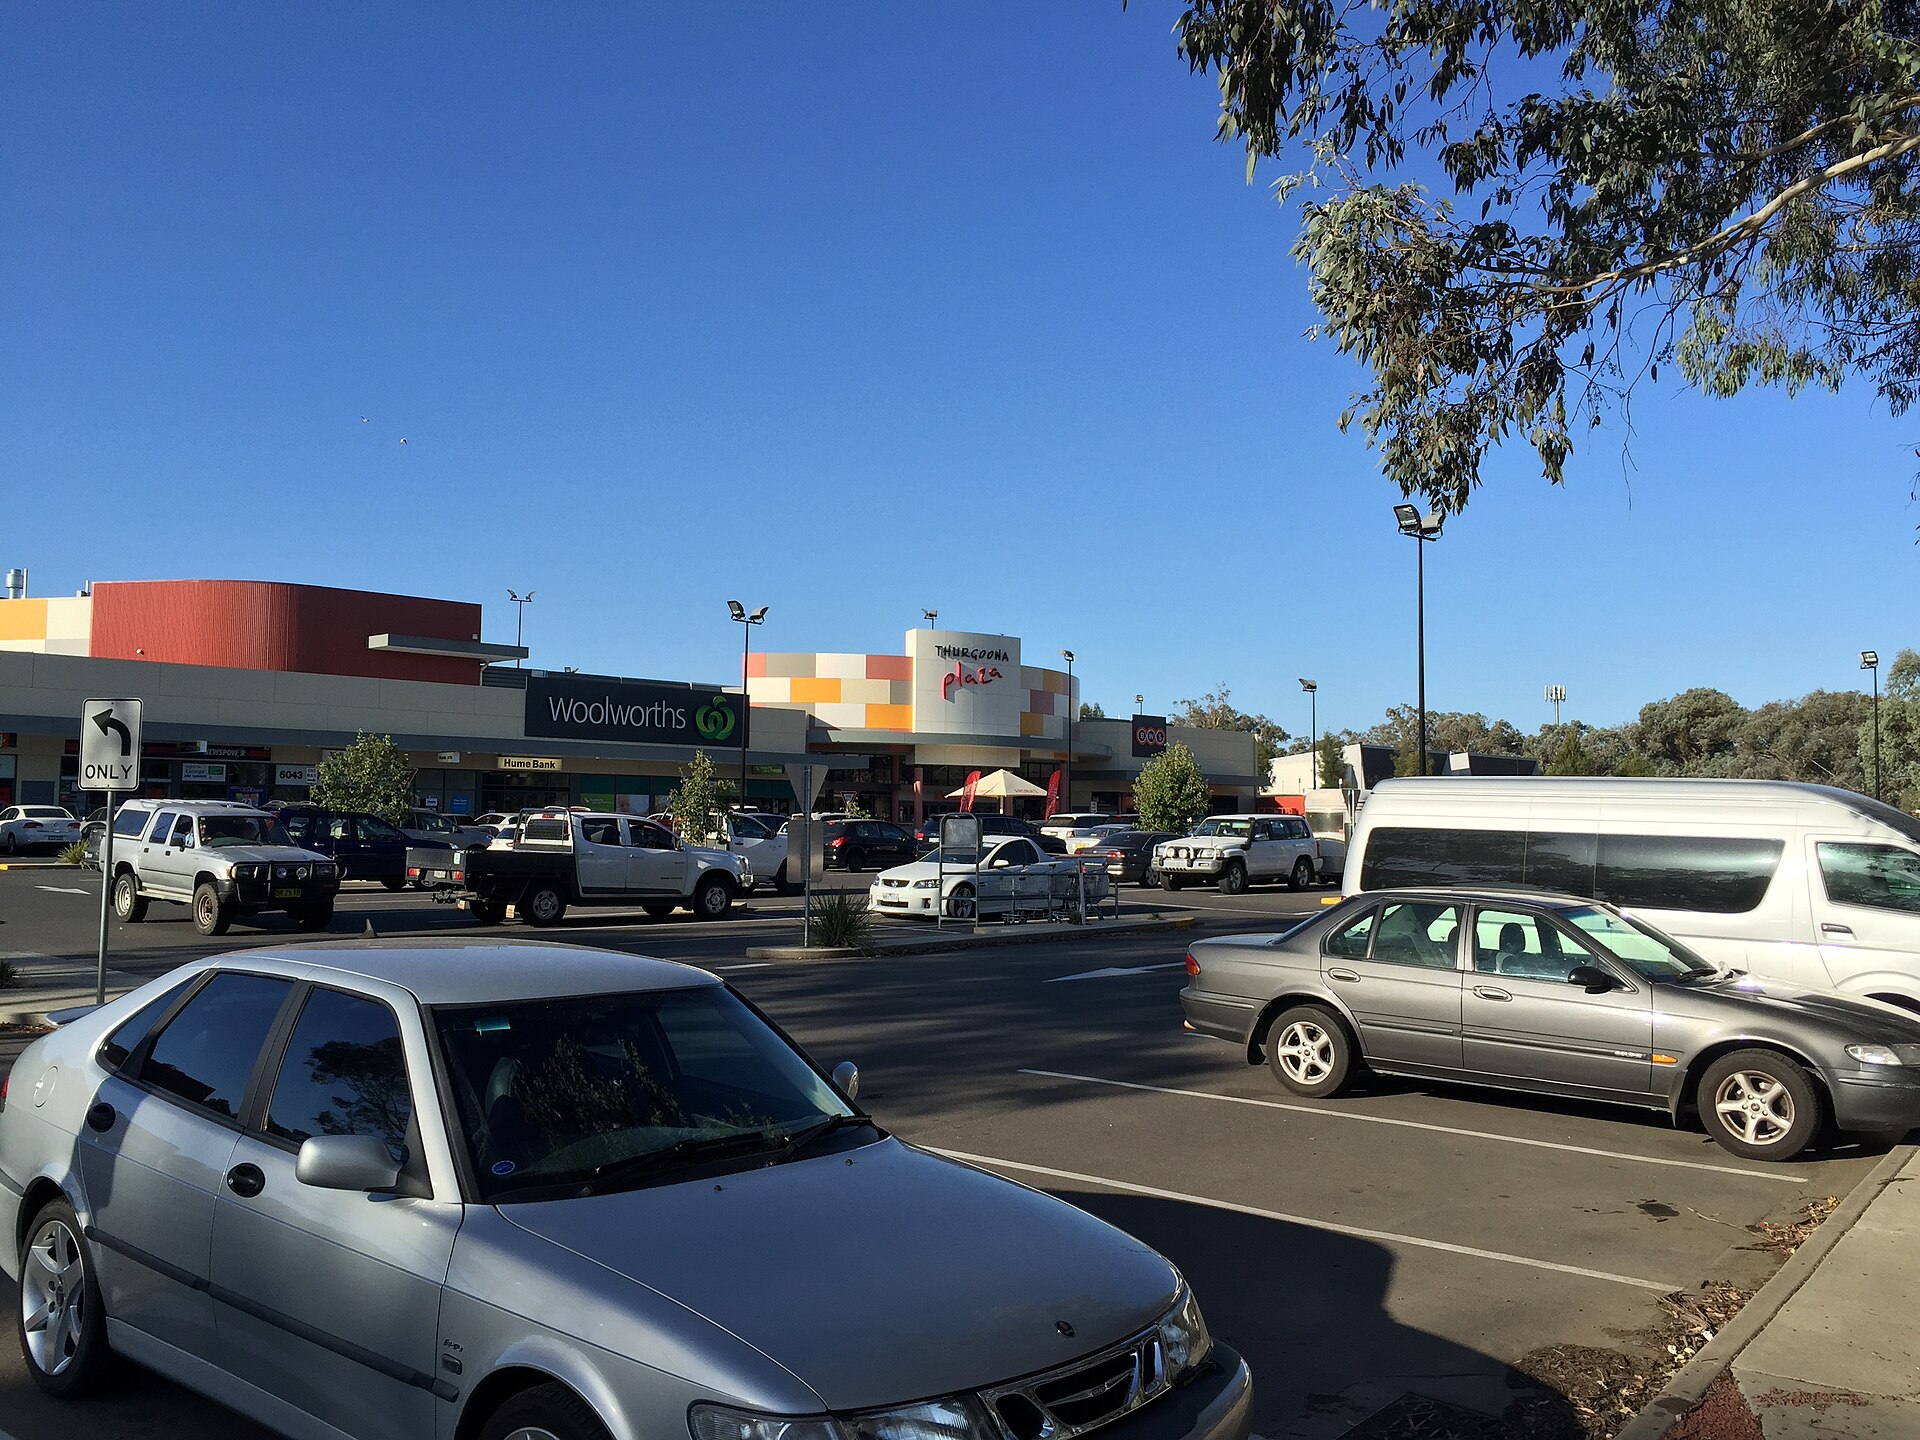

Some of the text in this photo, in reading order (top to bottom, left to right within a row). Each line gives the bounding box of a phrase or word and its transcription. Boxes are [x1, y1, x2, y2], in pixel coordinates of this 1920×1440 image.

[935, 645, 1009, 662] THURGOONA
[942, 661, 1003, 700] plaza
[549, 695, 687, 729] Woolworths
[85, 764, 133, 779] ONLY
[504, 759, 556, 769] Hume Bank
[280, 770, 303, 779] 6043
